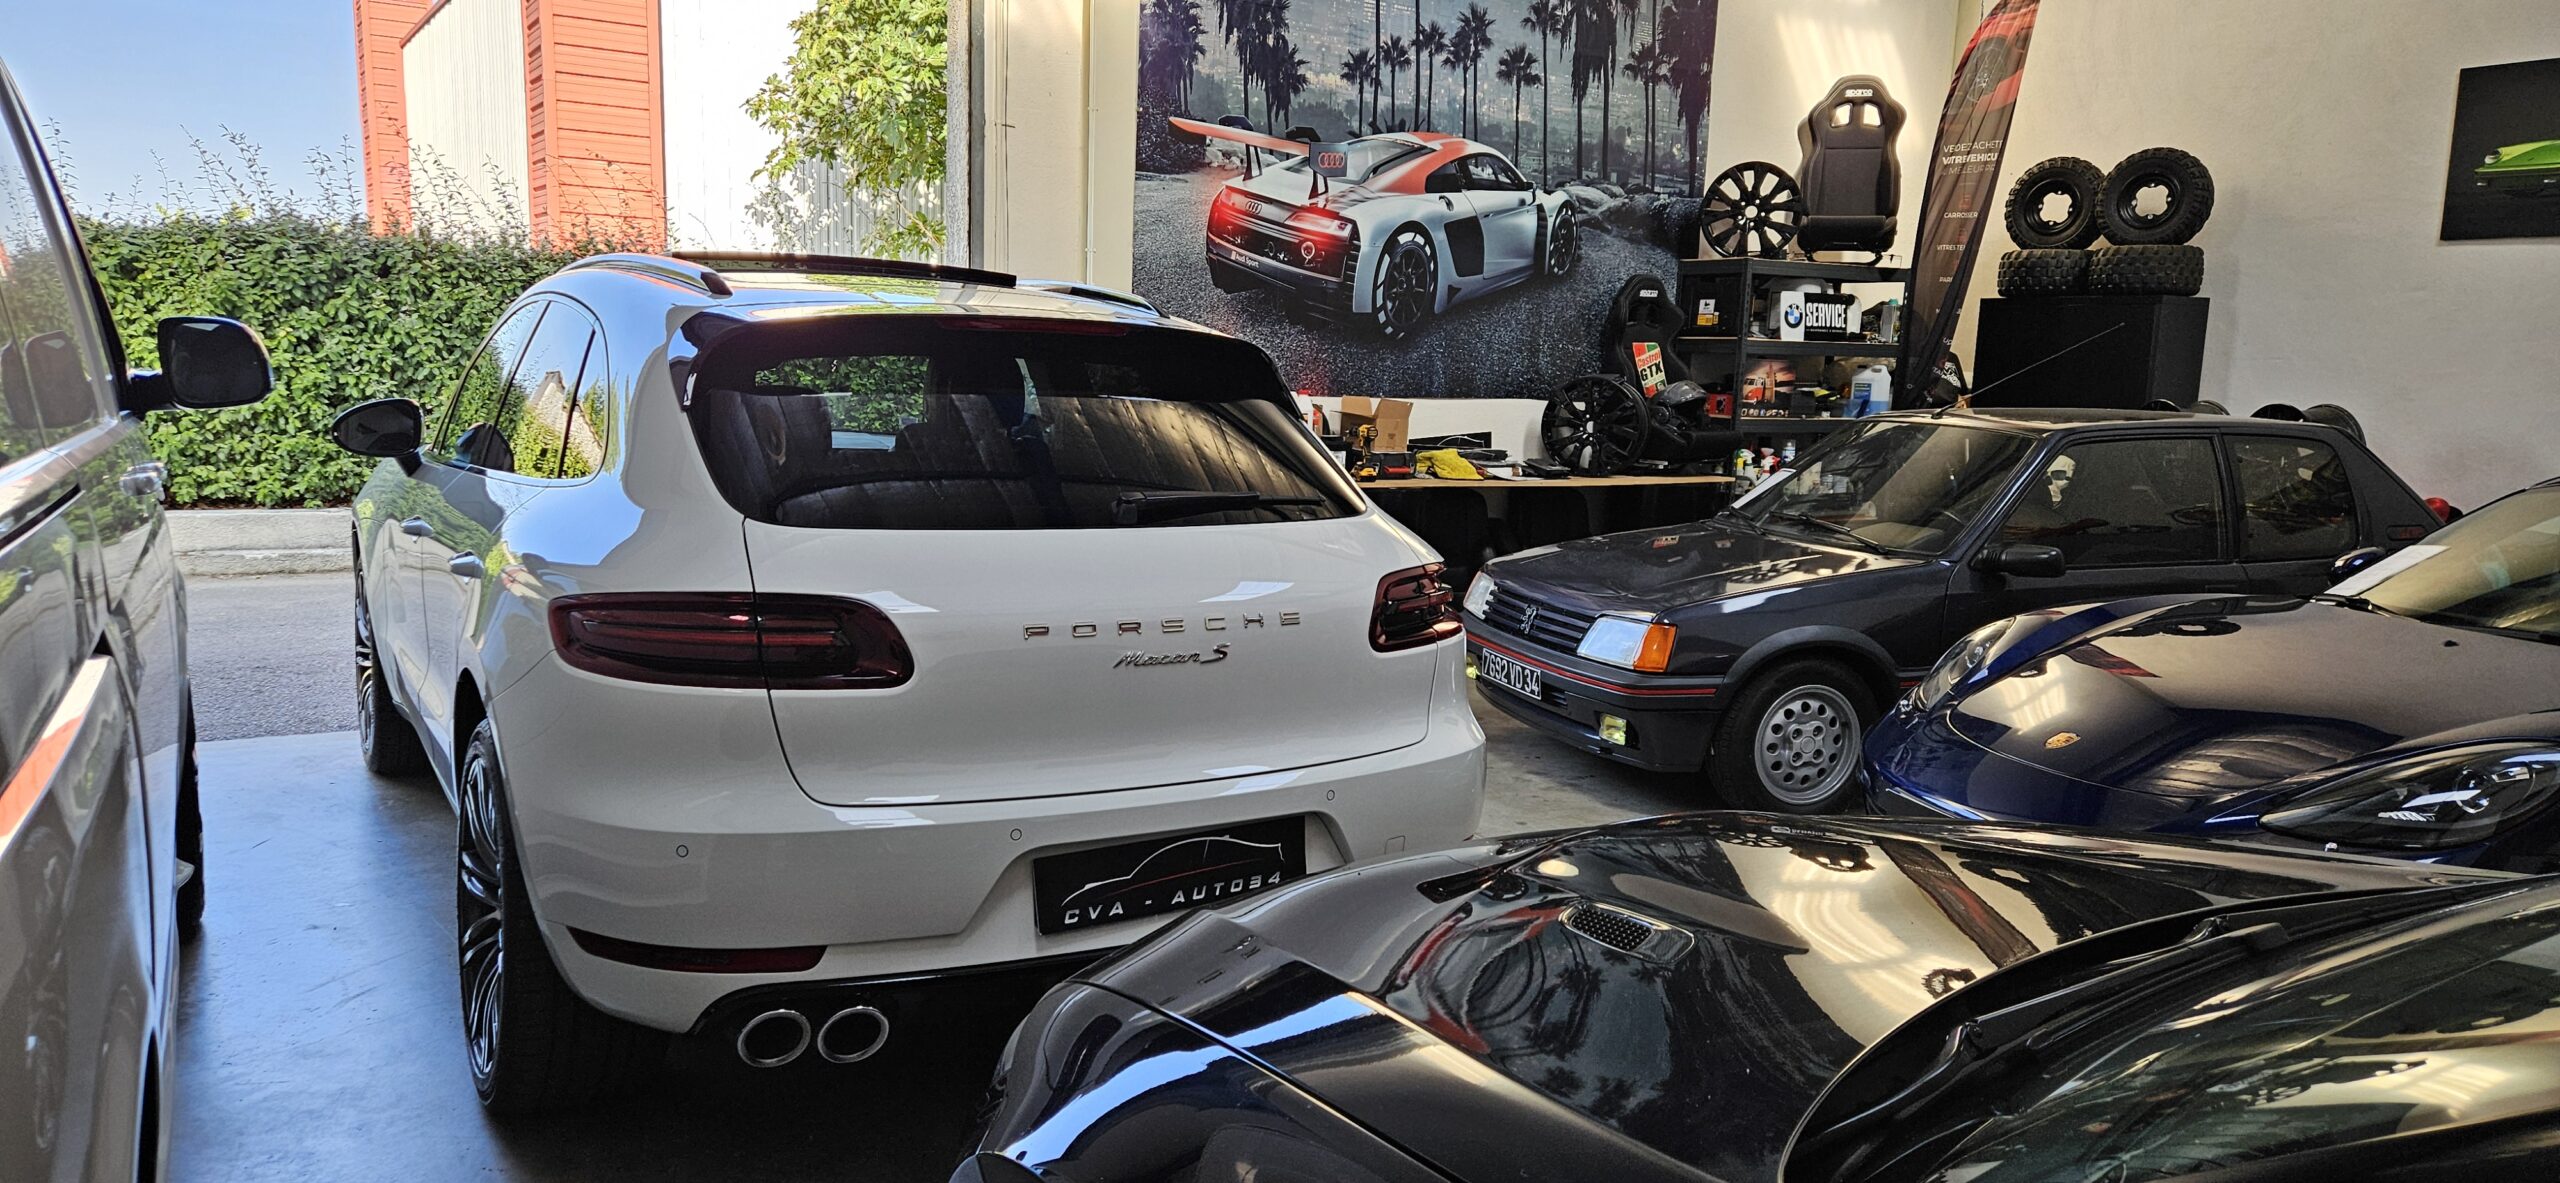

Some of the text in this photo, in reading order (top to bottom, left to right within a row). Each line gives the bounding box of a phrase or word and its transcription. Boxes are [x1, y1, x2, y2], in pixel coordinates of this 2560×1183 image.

[1805, 302, 1846, 328] SERVICE
[1636, 349, 1661, 369] Castrol
[1640, 360, 1664, 382] GTX
[1022, 611, 1301, 640] PORSCHE
[1112, 642, 1232, 669] Macan S
[1483, 651, 1539, 696] 7692 VD 34
[1064, 901, 1125, 925] CVA
[1171, 871, 1281, 905] AUTO34
